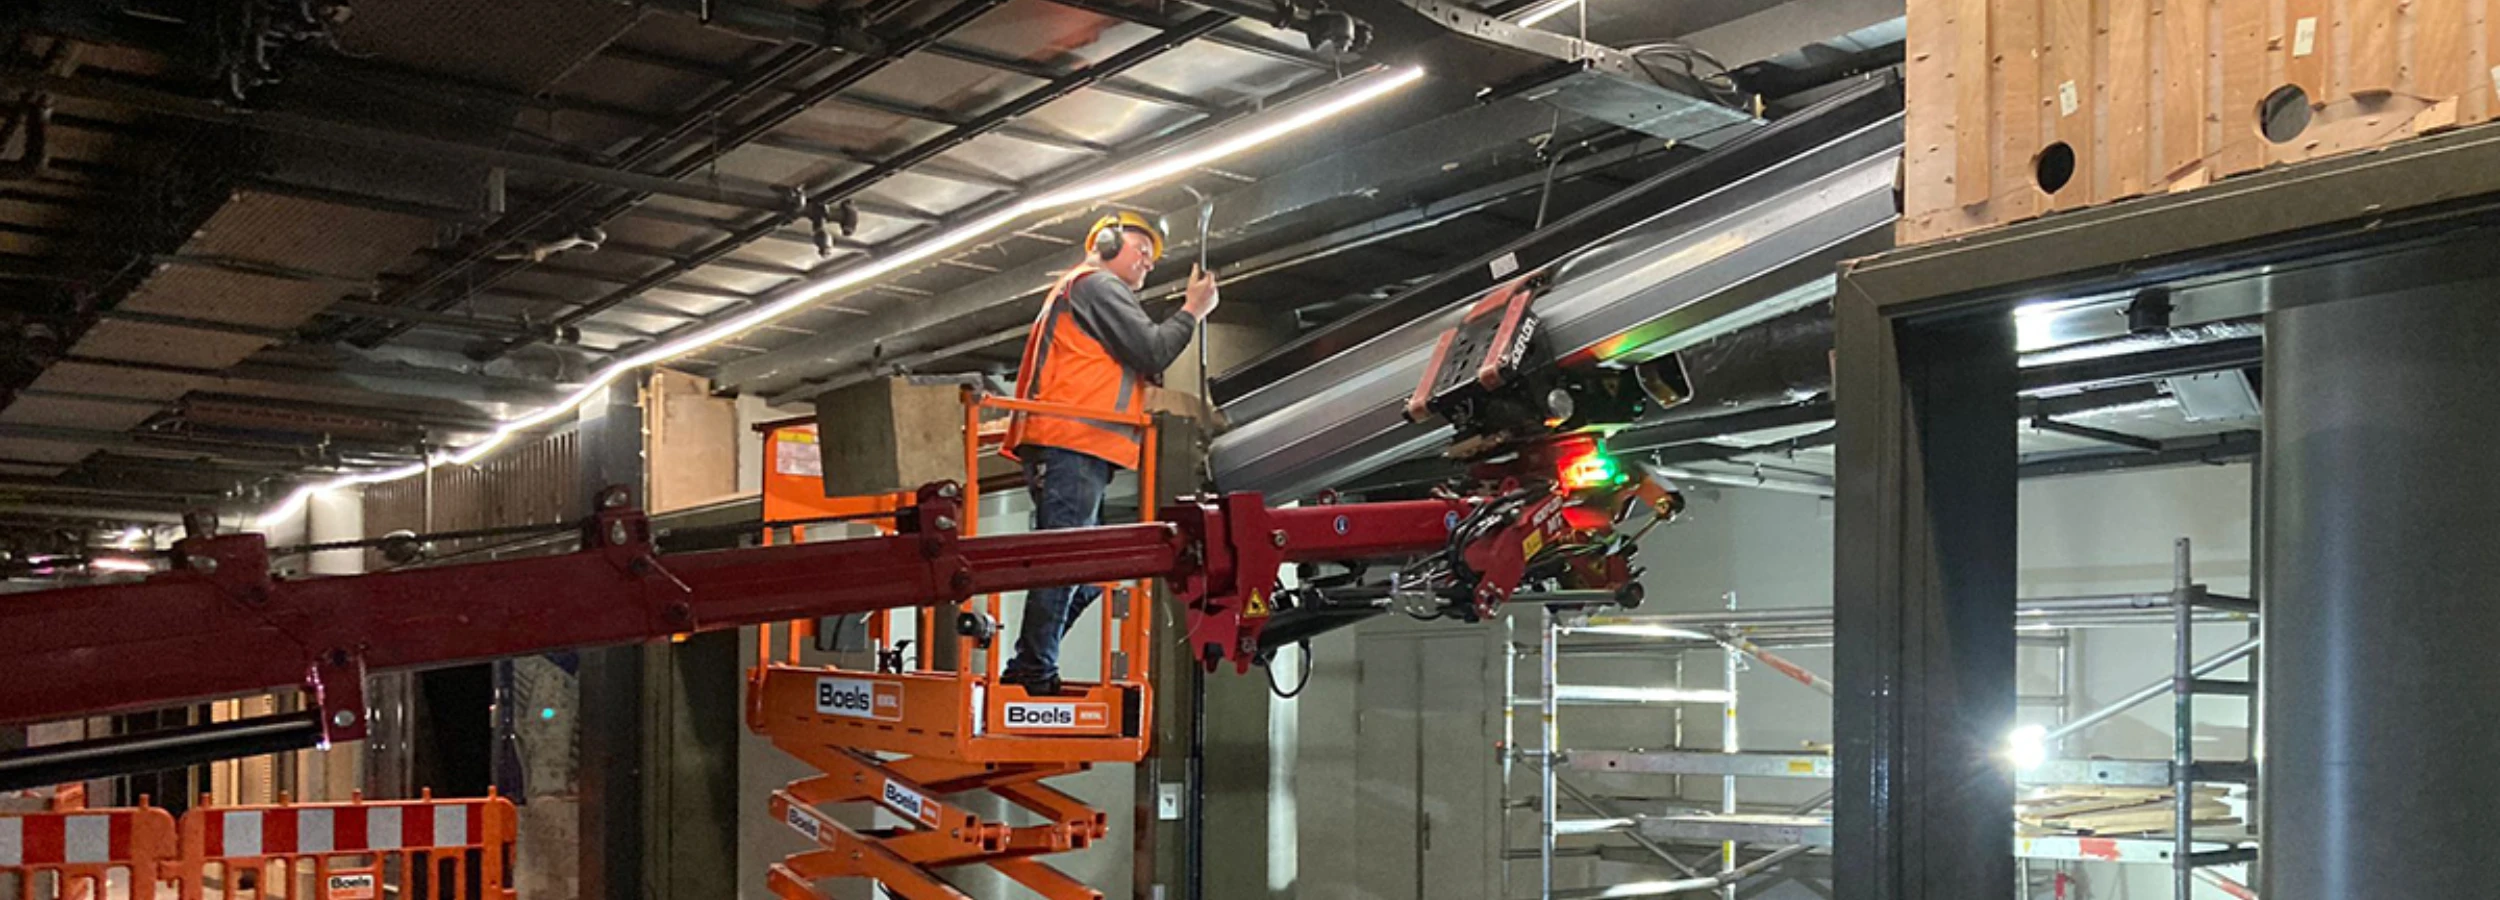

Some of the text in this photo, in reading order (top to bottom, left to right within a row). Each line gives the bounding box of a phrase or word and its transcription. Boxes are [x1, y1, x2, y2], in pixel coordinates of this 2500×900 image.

[820, 683, 870, 710] Boels
[1008, 706, 1072, 724] Boels
[885, 783, 919, 813] Boels
[789, 808, 818, 837] Boels
